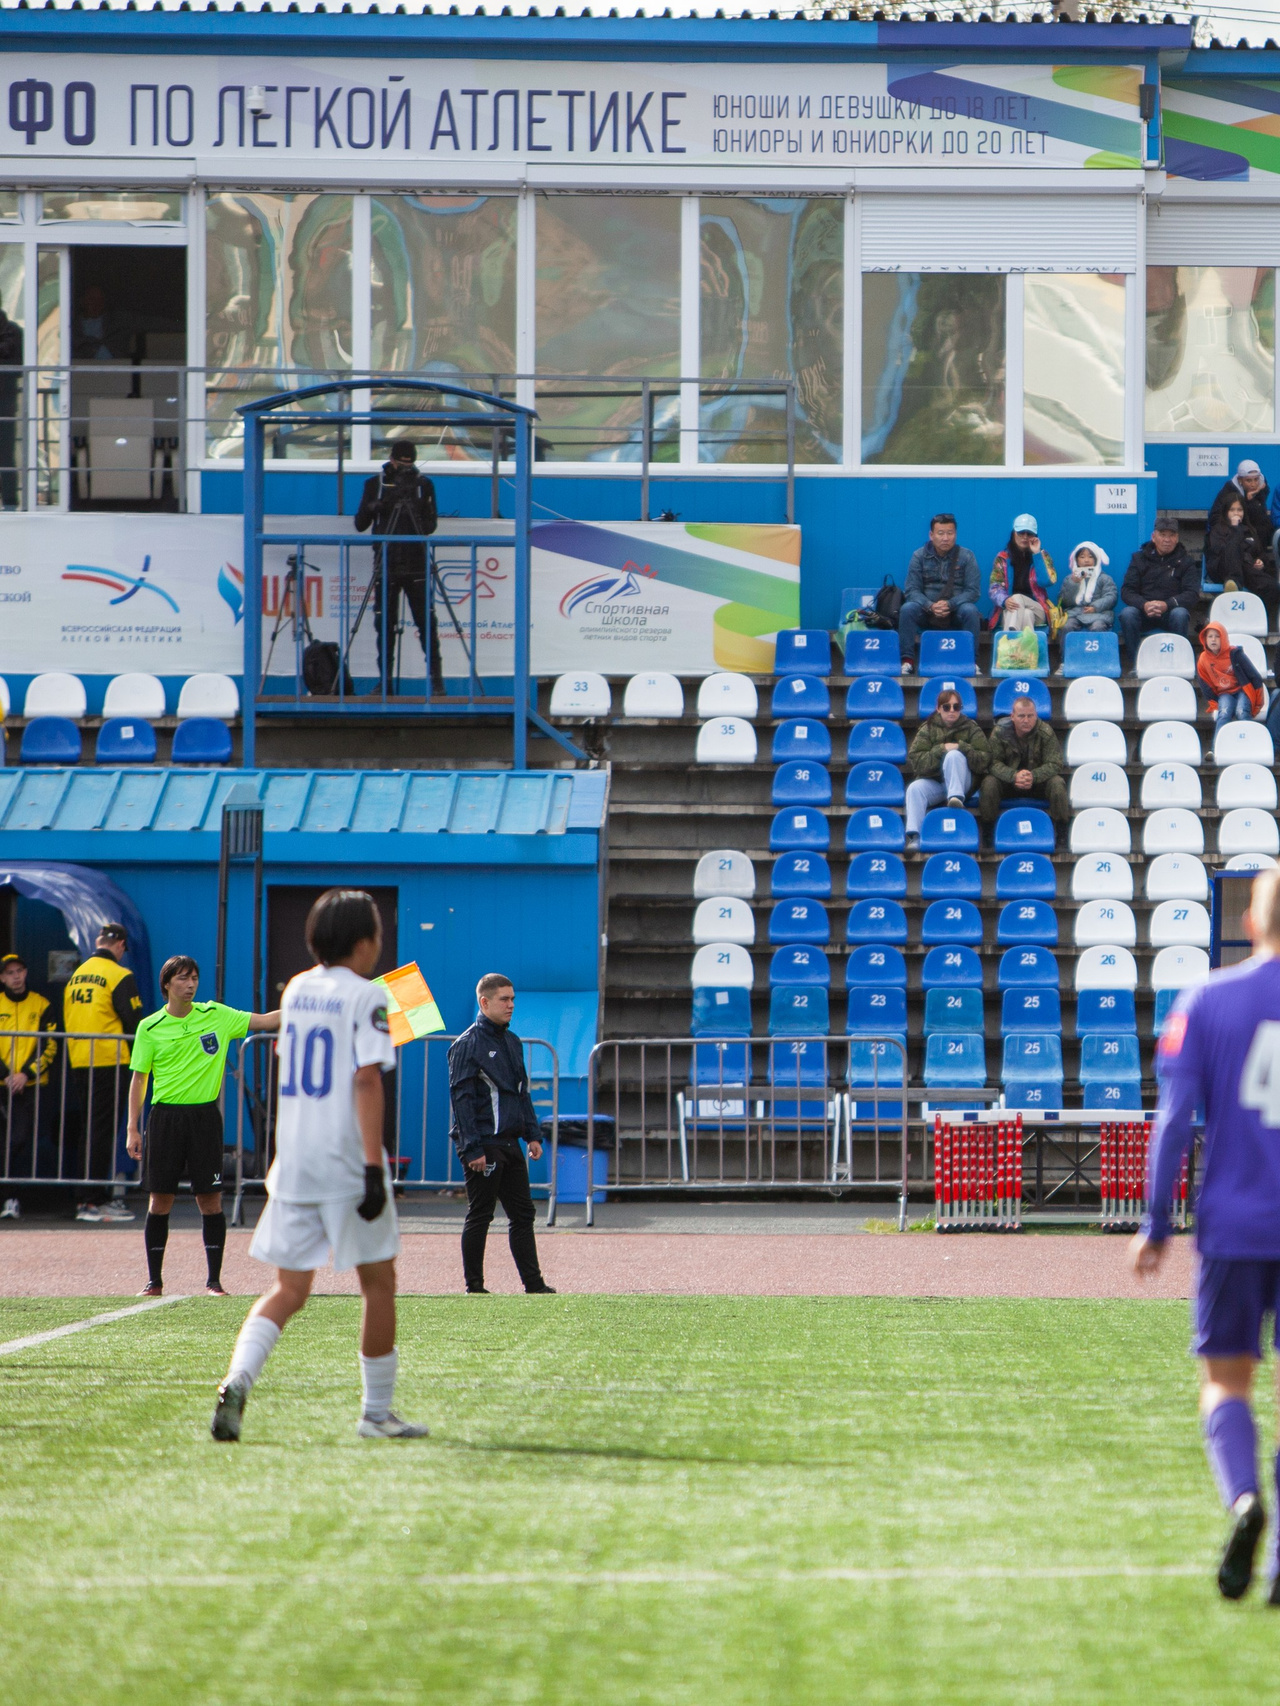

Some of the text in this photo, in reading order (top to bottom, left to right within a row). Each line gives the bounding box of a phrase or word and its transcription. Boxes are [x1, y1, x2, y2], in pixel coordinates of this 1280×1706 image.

[714, 95, 790, 119] ЮНОШИ
[797, 95, 811, 120] И
[818, 95, 922, 121] ДЕВУШКИ
[929, 97, 958, 121] ДО
[966, 96, 985, 120] 18
[130, 85, 195, 146] ПО
[212, 75, 411, 150] ЛЕГКОЙ
[430, 89, 688, 154] АТЛЕТИКЕ
[714, 129, 1050, 157] ЮНИОРЫ И ЮНИОРКИ ДО 20 ЛЕТ
[1108, 488, 1126, 496] VIP
[585, 601, 669, 616] Спортивная
[1231, 600, 1245, 611] 24
[601, 616, 647, 626] школа
[61, 624, 181, 633] ВСЕРОССИЙСКАЯ ФЕДЕРАЦИЯ
[579, 626, 672, 635] олимпийского резерва
[865, 639, 879, 649] 22
[941, 639, 955, 649] 23
[1085, 640, 1099, 651] 25
[1160, 643, 1174, 652] 26
[574, 682, 588, 692] 33
[868, 682, 882, 692] 37
[1015, 682, 1029, 693] 39
[722, 725, 735, 735] 35
[870, 727, 884, 737] 37
[795, 770, 809, 780] 36
[868, 770, 883, 781] 37
[1092, 772, 1106, 781] 40
[1161, 770, 1174, 781] 41
[719, 859, 732, 870] 21
[794, 860, 809, 872] 22
[870, 860, 886, 871] 23
[945, 860, 960, 872] 24
[1018, 861, 1033, 873] 25
[1097, 862, 1110, 872] 26
[720, 908, 731, 918] 21
[792, 907, 807, 918] 22
[869, 907, 884, 918] 23
[946, 908, 962, 919] 24
[1019, 907, 1035, 919] 25
[1100, 908, 1114, 919] 26
[1174, 910, 1188, 920] 27
[718, 953, 730, 964] 21
[793, 952, 809, 964] 22
[869, 953, 885, 965] 23
[945, 953, 961, 966] 24
[1021, 953, 1037, 965] 25
[1101, 955, 1115, 965] 26
[71, 988, 94, 1004] 143
[793, 995, 808, 1007] 22
[871, 994, 886, 1006] 23
[947, 996, 962, 1007] 24
[1024, 996, 1039, 1008] 25
[1100, 996, 1115, 1008] 26
[948, 1043, 963, 1054] 24
[1025, 1043, 1040, 1054] 25
[1103, 1042, 1119, 1054] 26
[281, 1022, 333, 1098] 10
[1027, 1090, 1041, 1101] 25
[1105, 1088, 1120, 1099] 26
